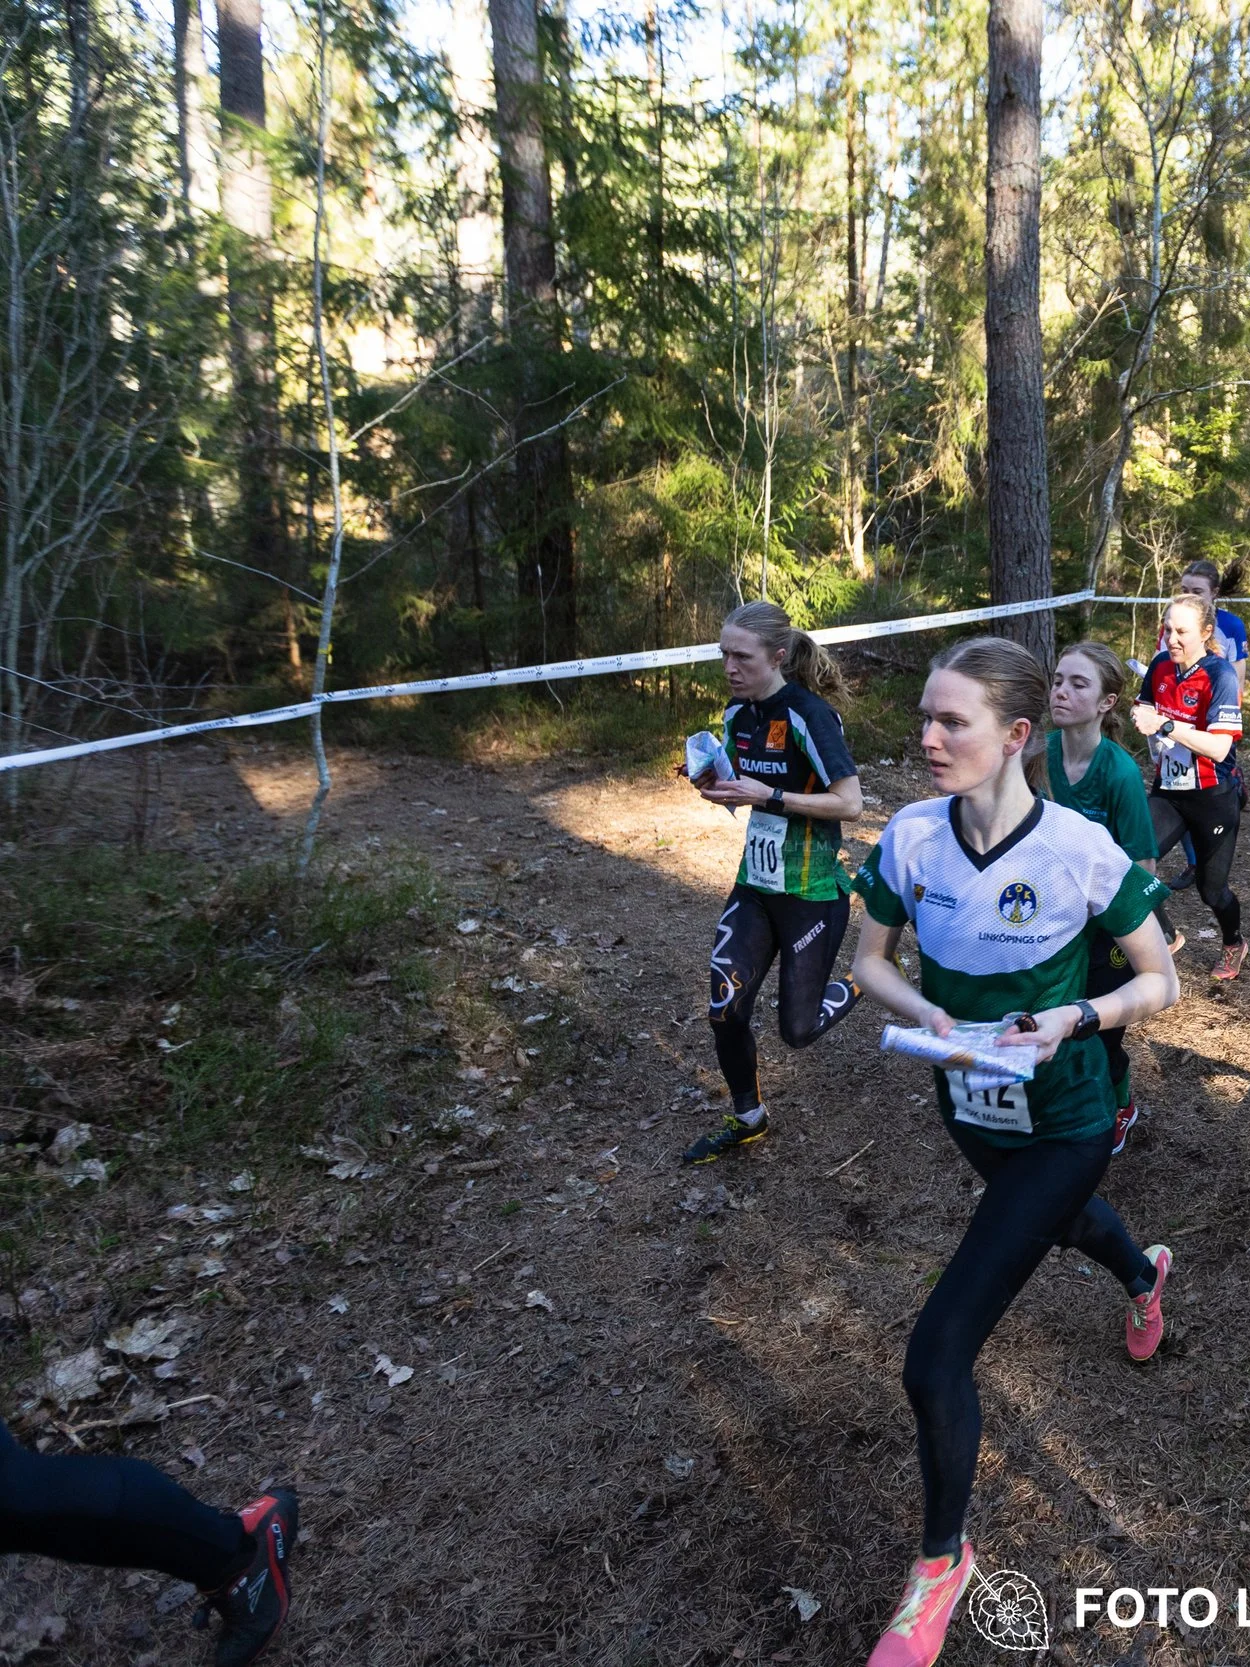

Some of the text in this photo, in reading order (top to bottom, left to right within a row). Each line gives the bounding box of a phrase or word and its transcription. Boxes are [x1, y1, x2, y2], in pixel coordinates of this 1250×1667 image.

[750, 835, 778, 874] 110
[792, 920, 826, 954] TRIMTEX
[979, 931, 1035, 944] LINKÖPINGS
[982, 1113, 1019, 1125] Måsen
